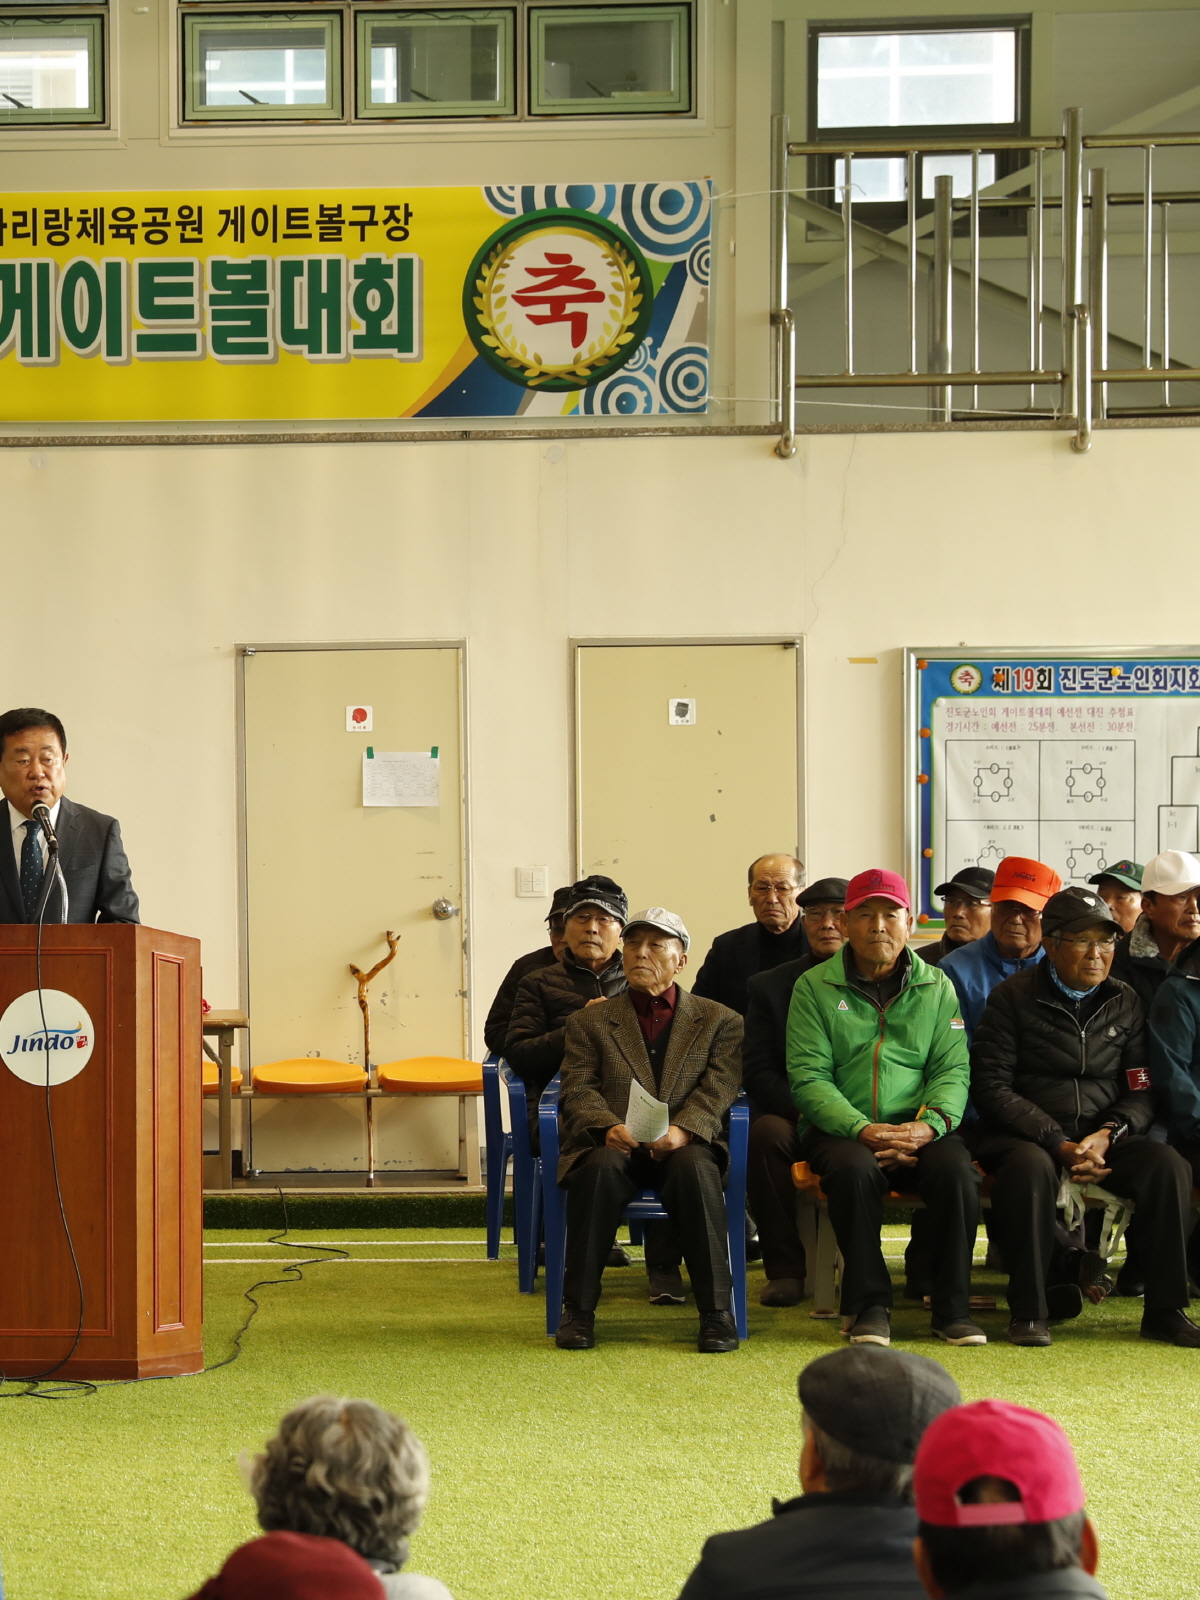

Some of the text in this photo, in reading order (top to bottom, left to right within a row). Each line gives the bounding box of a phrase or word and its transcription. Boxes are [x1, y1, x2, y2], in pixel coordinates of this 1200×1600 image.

[216, 203, 414, 244] 게이트볼구장
[511, 251, 606, 349] 축
[993, 668, 1052, 691] 제19회
[946, 706, 997, 718] 진도군노인회
[1001, 706, 1052, 718] 게이트볼대회
[1056, 706, 1082, 718] 예선전
[1087, 706, 1104, 718] 대진
[946, 721, 980, 733] 경기시간
[991, 721, 1017, 732] 예선전
[1069, 721, 1095, 732] 본선전
[6, 1034, 75, 1055] Jindo
